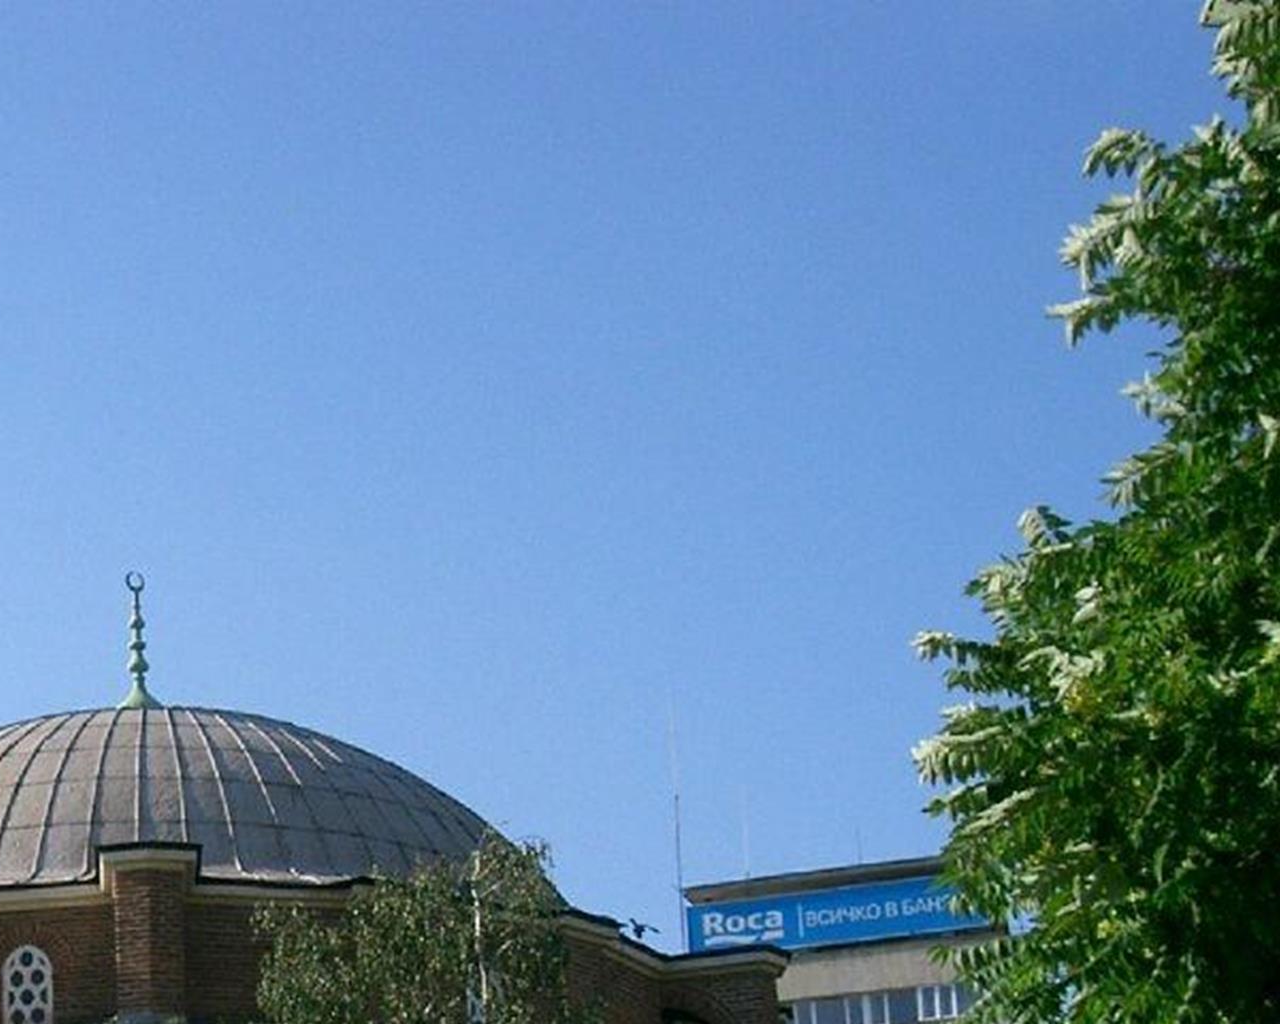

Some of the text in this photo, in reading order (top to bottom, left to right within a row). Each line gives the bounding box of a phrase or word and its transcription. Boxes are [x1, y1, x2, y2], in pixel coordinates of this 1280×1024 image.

[703, 910, 783, 936] Roca
[805, 903, 881, 928] ВСИЧКО
[884, 901, 898, 918] В
